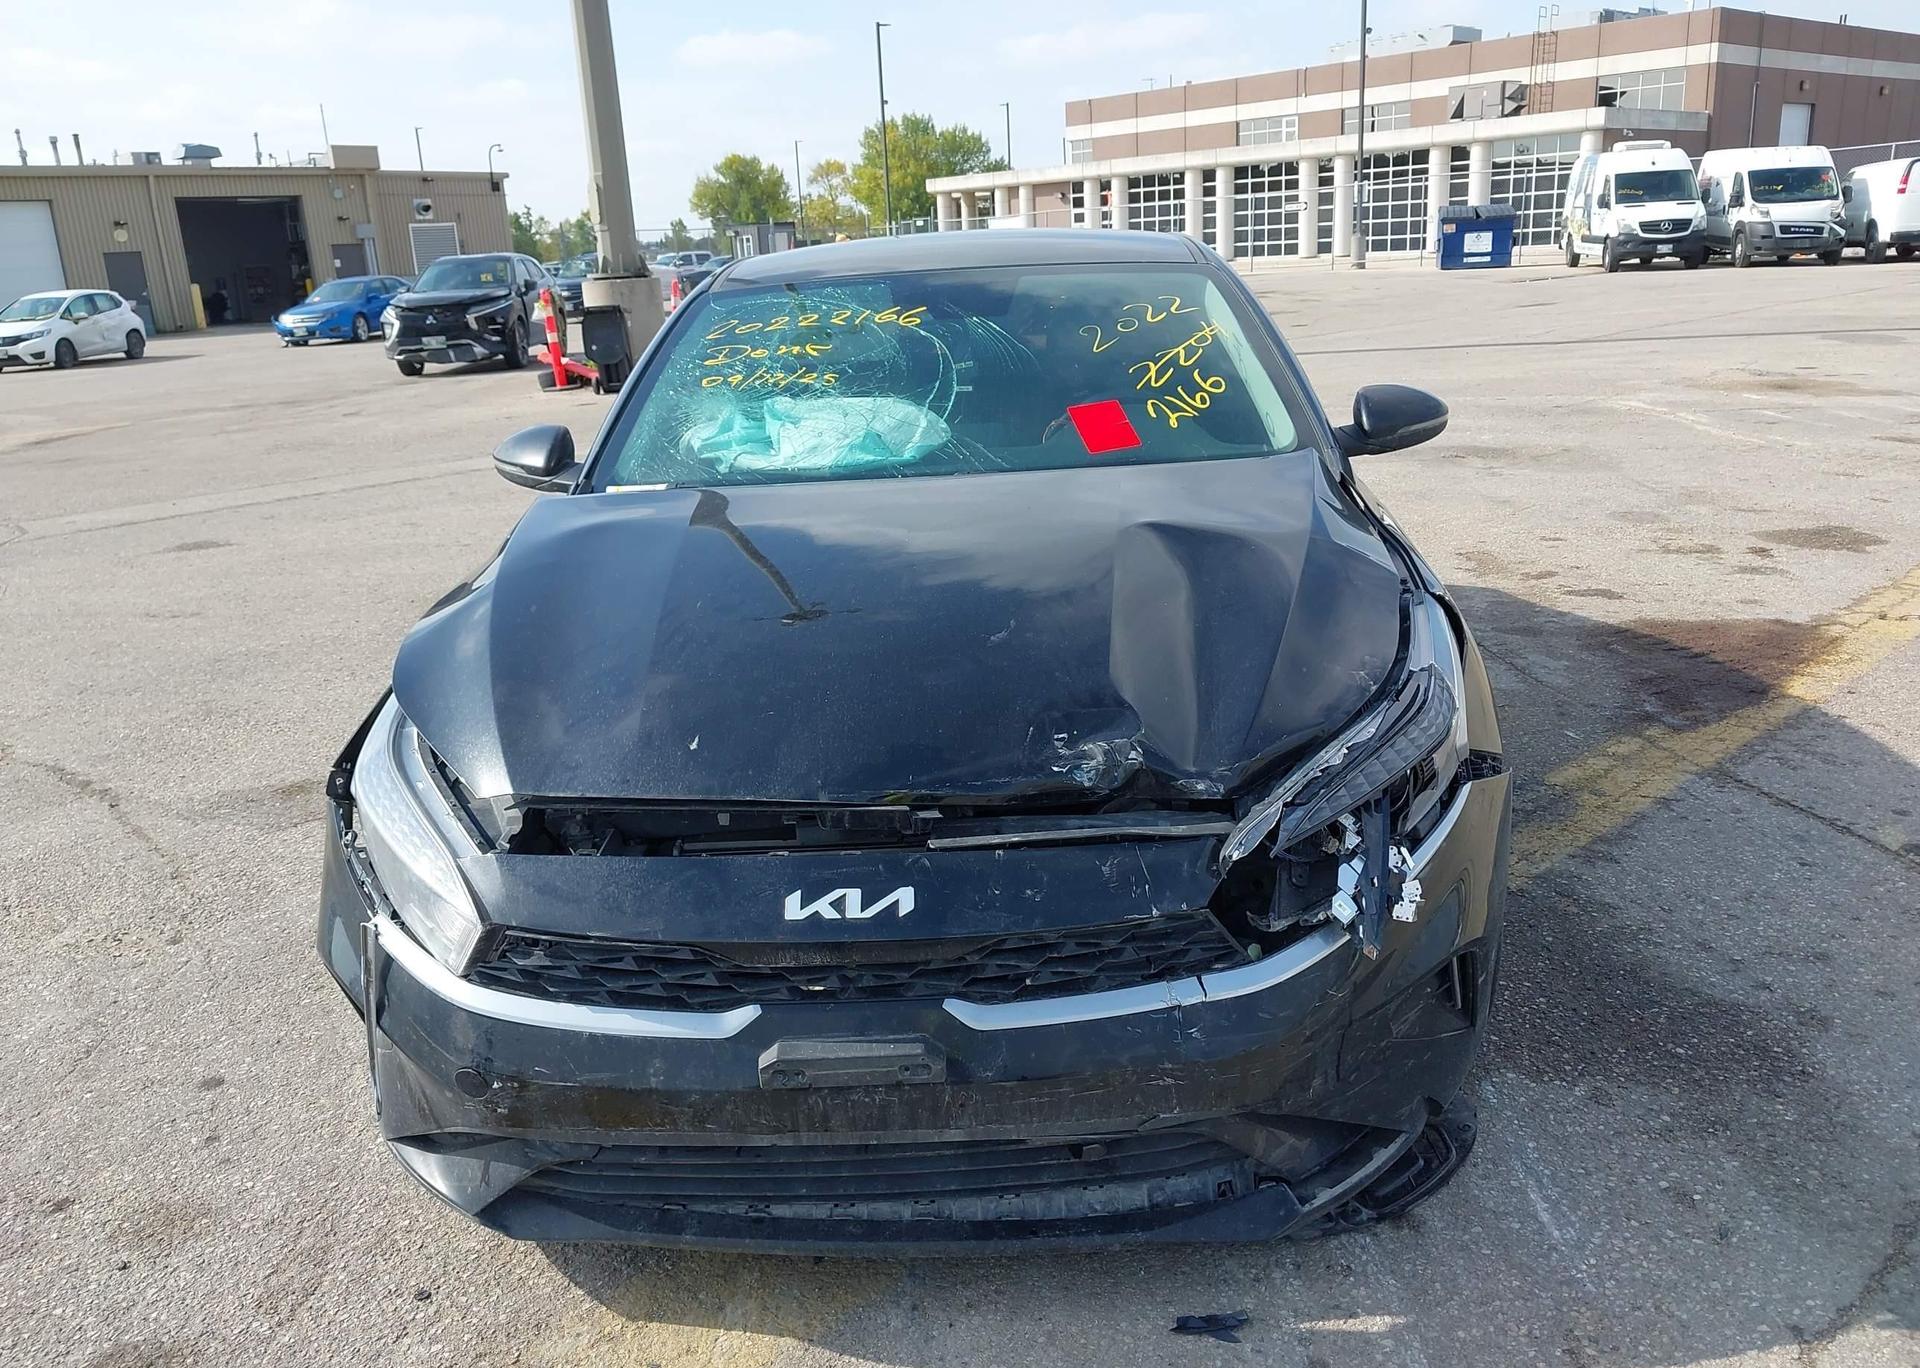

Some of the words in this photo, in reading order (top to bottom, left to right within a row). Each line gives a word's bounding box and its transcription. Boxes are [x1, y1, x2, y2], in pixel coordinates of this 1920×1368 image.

[706, 306, 928, 340] 20222166
[1079, 295, 1200, 353] 2022
[1146, 368, 1226, 429] 2166
[784, 886, 915, 921] KIA
